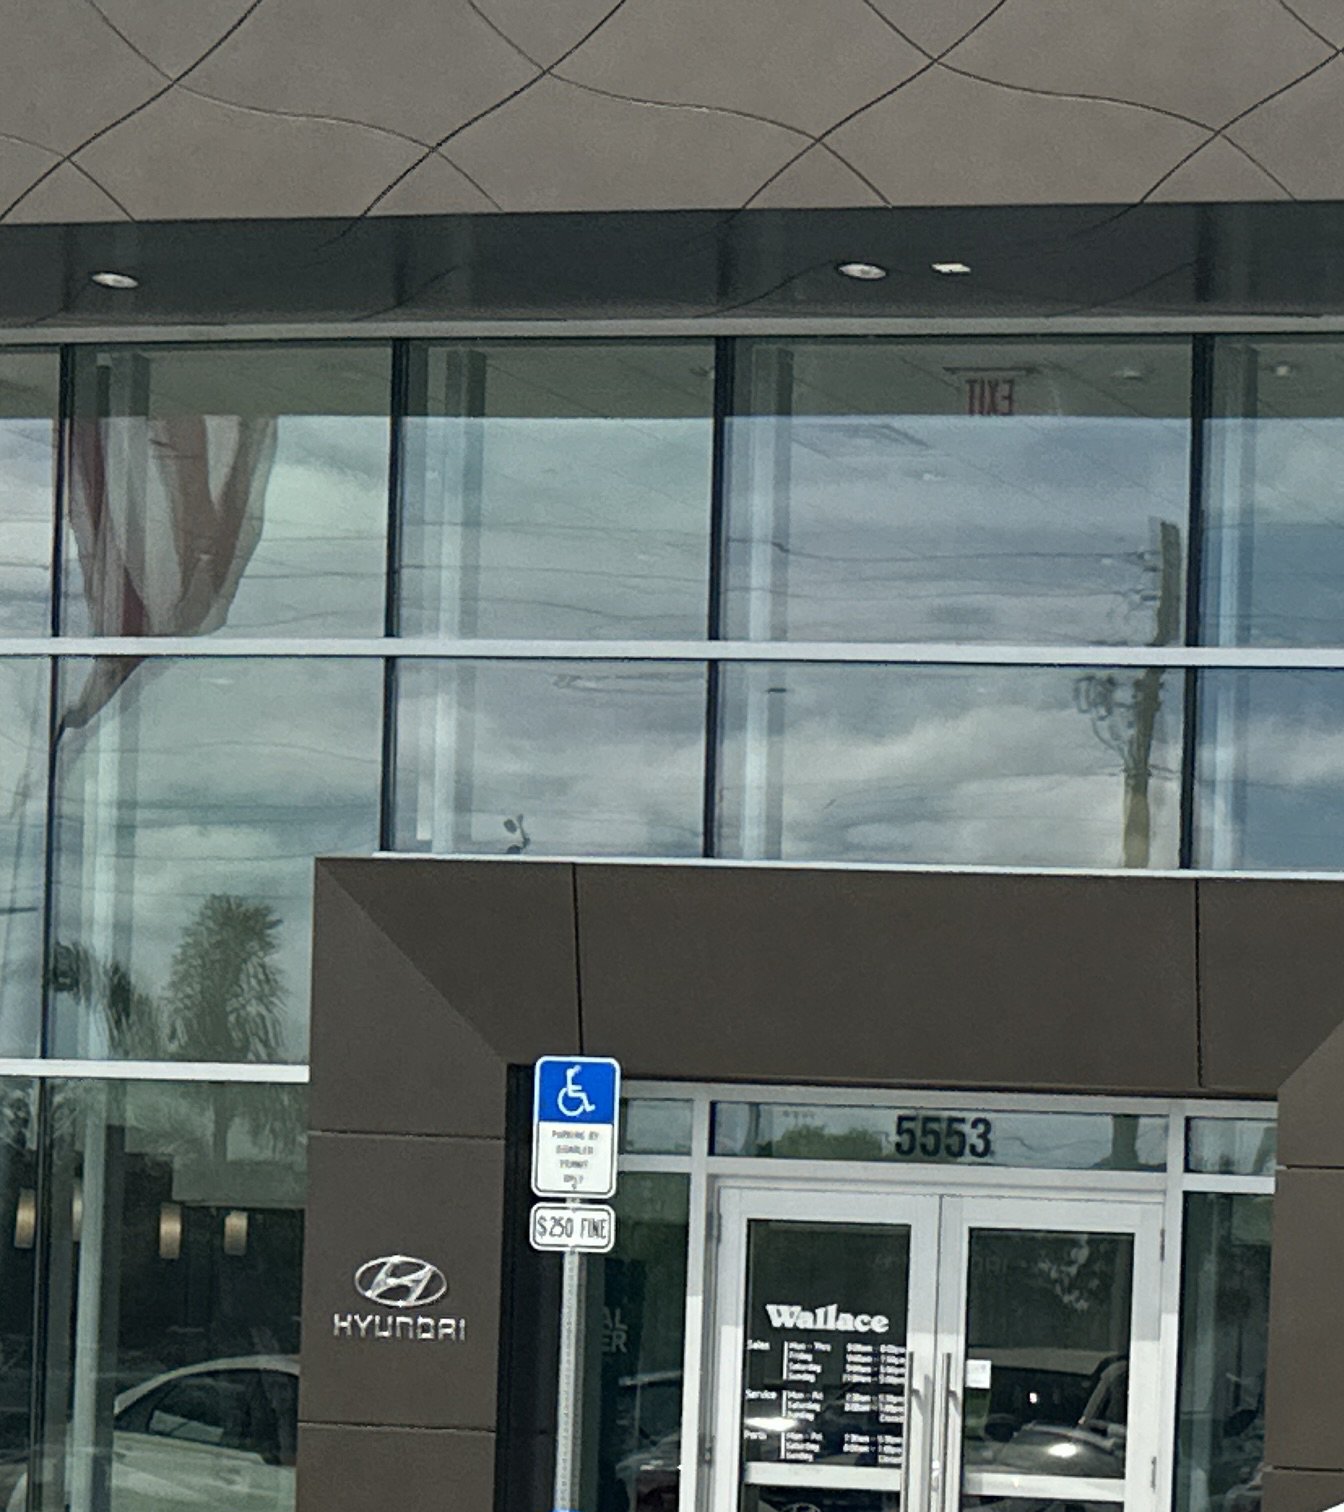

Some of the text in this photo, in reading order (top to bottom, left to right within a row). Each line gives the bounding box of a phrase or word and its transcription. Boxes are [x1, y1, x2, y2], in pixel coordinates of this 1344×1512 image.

[895, 1114, 992, 1158] 5553
[333, 1313, 467, 1341] HYUNDAI
[765, 1303, 890, 1333] Wallace
